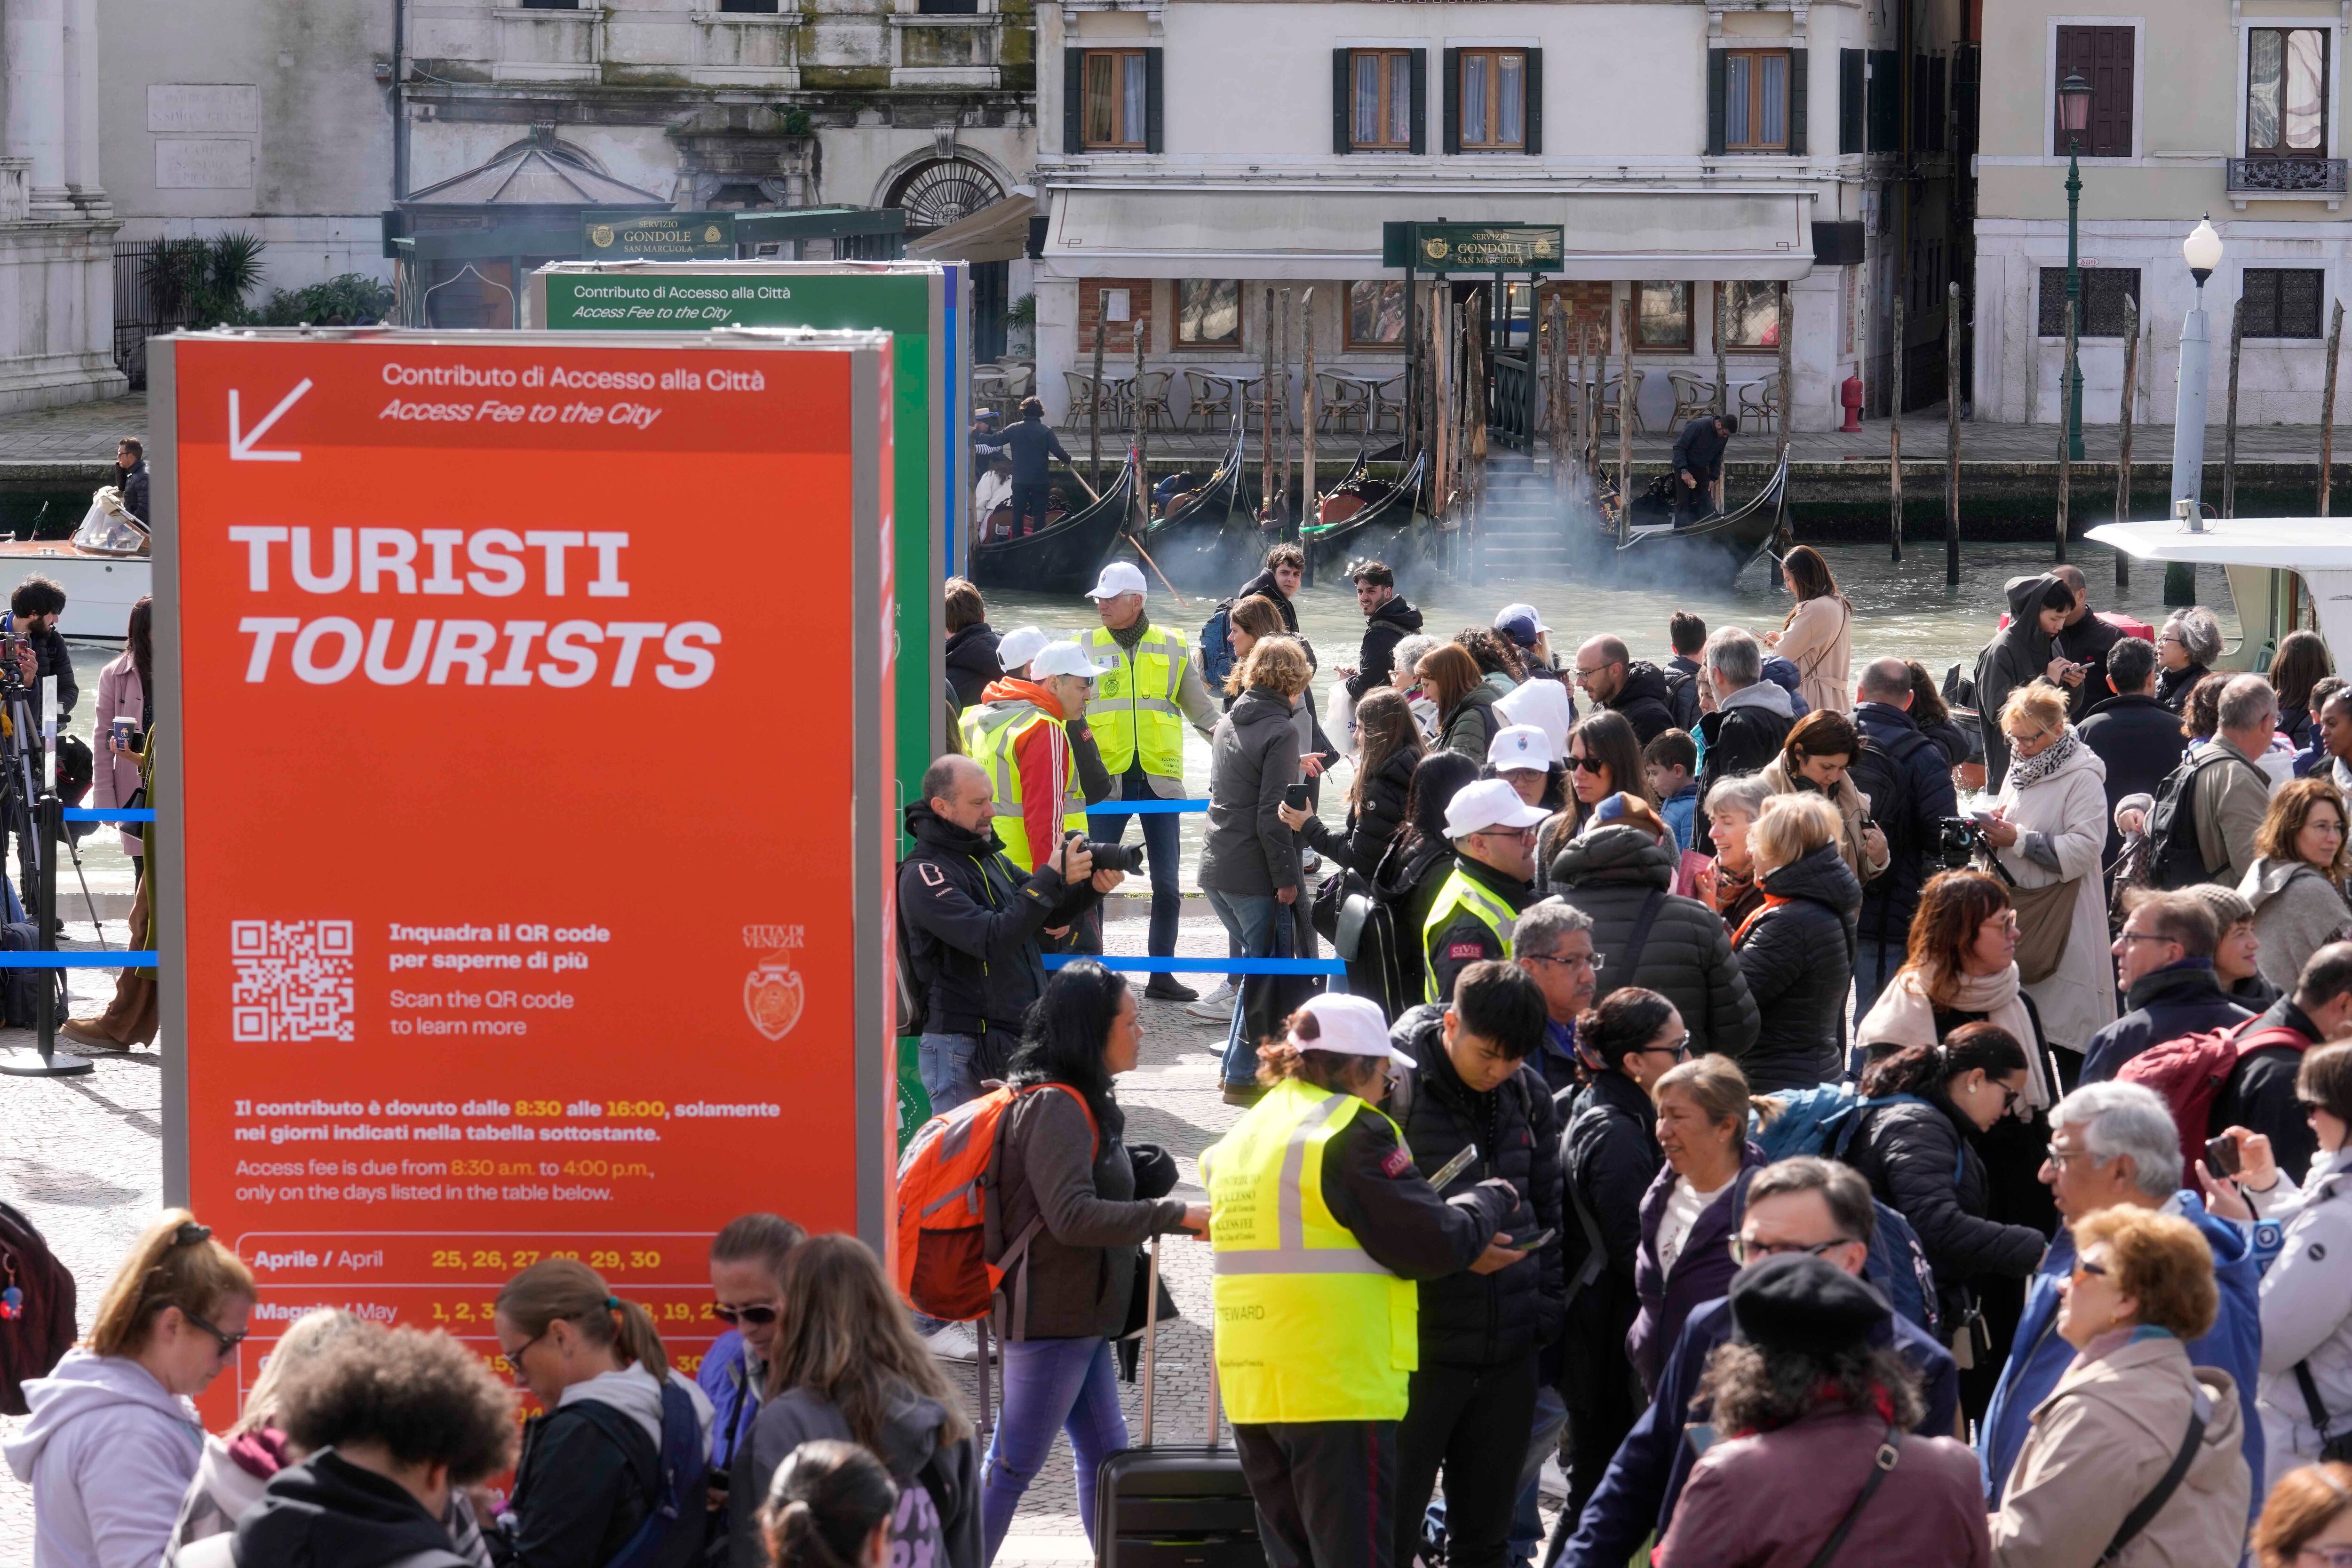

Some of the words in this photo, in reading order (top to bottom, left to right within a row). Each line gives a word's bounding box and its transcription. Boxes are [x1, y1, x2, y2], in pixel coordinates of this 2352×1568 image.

[624, 231, 691, 242] GONDOLE
[1458, 243, 1522, 254] GONDOLE
[574, 286, 650, 298] Contributo
[653, 287, 665, 298] di
[669, 287, 728, 299] Accesso
[732, 287, 754, 298] alla
[758, 287, 790, 299] Città
[572, 306, 625, 318] Access
[627, 306, 654, 318] Fee
[657, 308, 673, 318] to
[675, 306, 699, 318] the
[702, 307, 732, 321] City
[382, 363, 516, 387] Contributo
[522, 366, 544, 387] di
[550, 367, 655, 390] Accesso
[660, 368, 700, 390] alla
[707, 369, 764, 391] Città
[379, 399, 472, 421] Access
[475, 401, 523, 422] Fee
[528, 404, 556, 422] to
[560, 402, 604, 423] the
[607, 403, 662, 429] City
[229, 526, 629, 597] TURISTI
[238, 616, 721, 689] TOURISTS
[389, 923, 492, 945] Inquadra
[498, 923, 510, 941] il
[516, 924, 548, 941] QR
[554, 924, 610, 942] code
[743, 936, 804, 948] VENEZIA
[389, 954, 427, 971] per
[432, 955, 522, 972] saperne
[527, 951, 548, 969] di
[553, 952, 588, 973] più
[390, 990, 442, 1008] Scan
[447, 990, 481, 1008] the
[485, 990, 517, 1008] QR
[522, 991, 574, 1009] code
[390, 1019, 412, 1035] to
[417, 1017, 467, 1035] learn
[472, 1021, 526, 1035] more
[235, 1100, 251, 1116] Il
[256, 1099, 364, 1116] contributo
[368, 1100, 381, 1116] è
[385, 1099, 457, 1116] dovuto
[461, 1100, 510, 1116] dalle
[515, 1100, 562, 1116] 8:30
[566, 1100, 602, 1116] alle
[607, 1101, 670, 1120] 16:00,
[675, 1101, 780, 1117] solamente
[235, 1125, 265, 1140] nei
[270, 1125, 328, 1144] giorni
[334, 1124, 408, 1140] indicati
[413, 1124, 461, 1140] nella
[466, 1124, 534, 1140] tabella
[539, 1127, 660, 1141] sottostante.
[236, 1160, 304, 1176] Access
[309, 1159, 338, 1175] fee
[342, 1160, 358, 1175] is
[361, 1159, 397, 1175] due
[401, 1159, 446, 1176] from
[451, 1160, 494, 1176] 8:30
[498, 1163, 535, 1176] a.m.
[539, 1162, 559, 1176] to
[563, 1160, 607, 1176] 4:00
[612, 1163, 654, 1179] p.m.,
[236, 1185, 275, 1204] only
[279, 1187, 303, 1200] on
[308, 1184, 339, 1200] the
[343, 1184, 387, 1203] days
[391, 1184, 441, 1200] listed
[446, 1184, 462, 1200] in
[467, 1184, 498, 1200] the
[502, 1184, 548, 1201] table
[553, 1184, 613, 1201] below.
[254, 1250, 318, 1271] Aprile
[323, 1251, 333, 1266] /
[338, 1250, 382, 1271] April
[432, 1250, 467, 1270] 25,
[473, 1251, 507, 1270] 26,
[591, 1251, 625, 1271] 29,
[631, 1251, 660, 1267] 30
[356, 1303, 397, 1323] May
[433, 1303, 449, 1322] 1,
[455, 1303, 476, 1322] 2,
[664, 1303, 695, 1323] 19,
